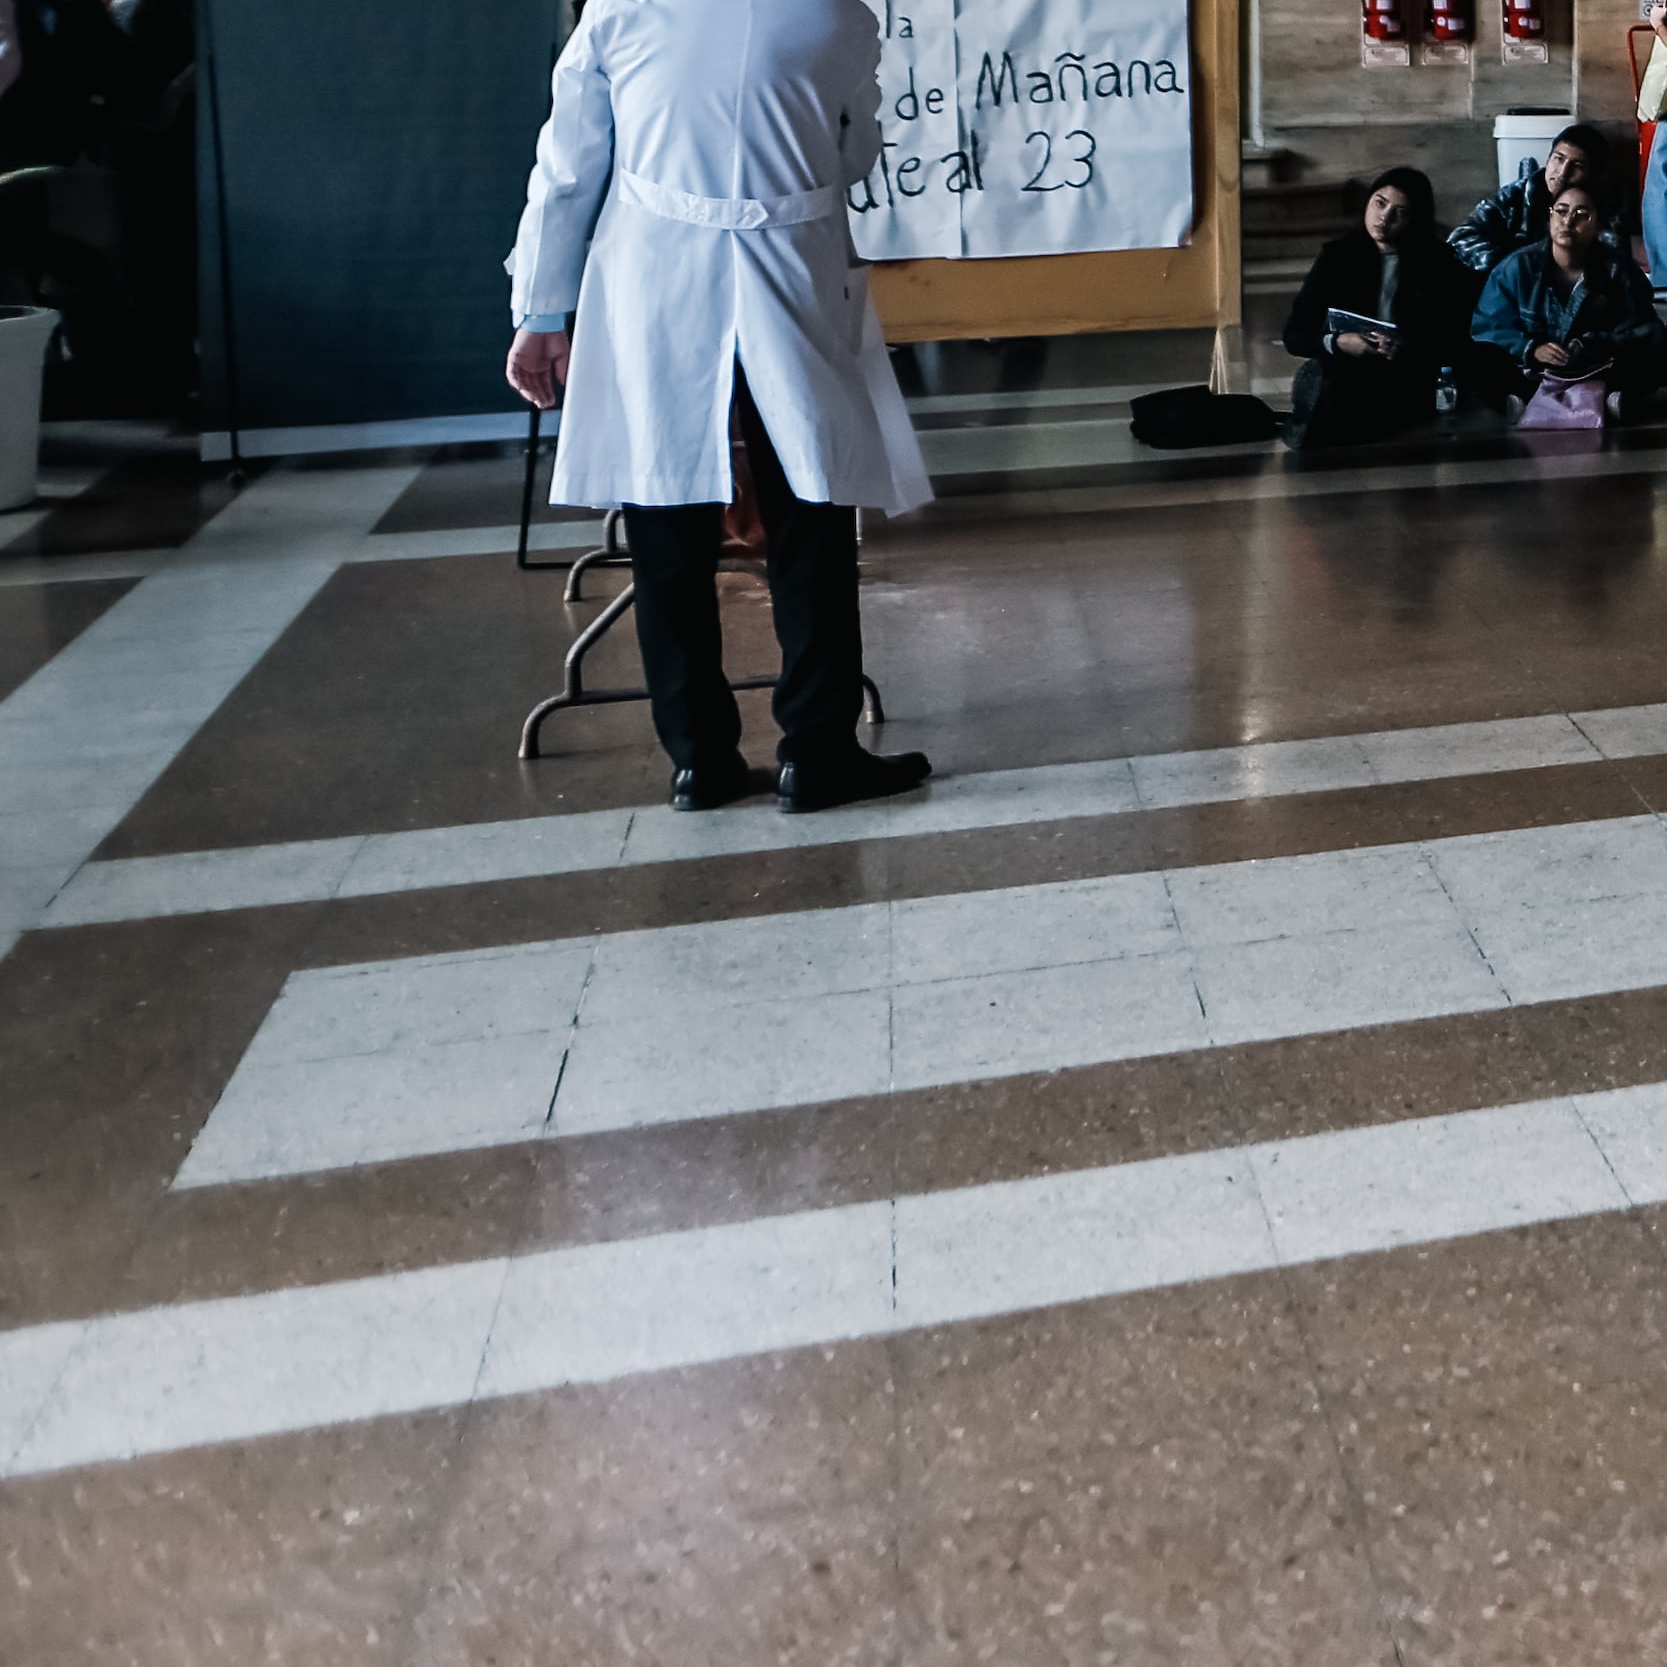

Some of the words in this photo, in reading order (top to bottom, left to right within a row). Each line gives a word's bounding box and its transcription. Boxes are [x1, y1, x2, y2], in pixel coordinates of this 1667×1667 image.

[895, 66, 944, 121] de
[976, 51, 1184, 110] Mañana
[940, 130, 985, 193] al
[1021, 130, 1097, 192] 23
